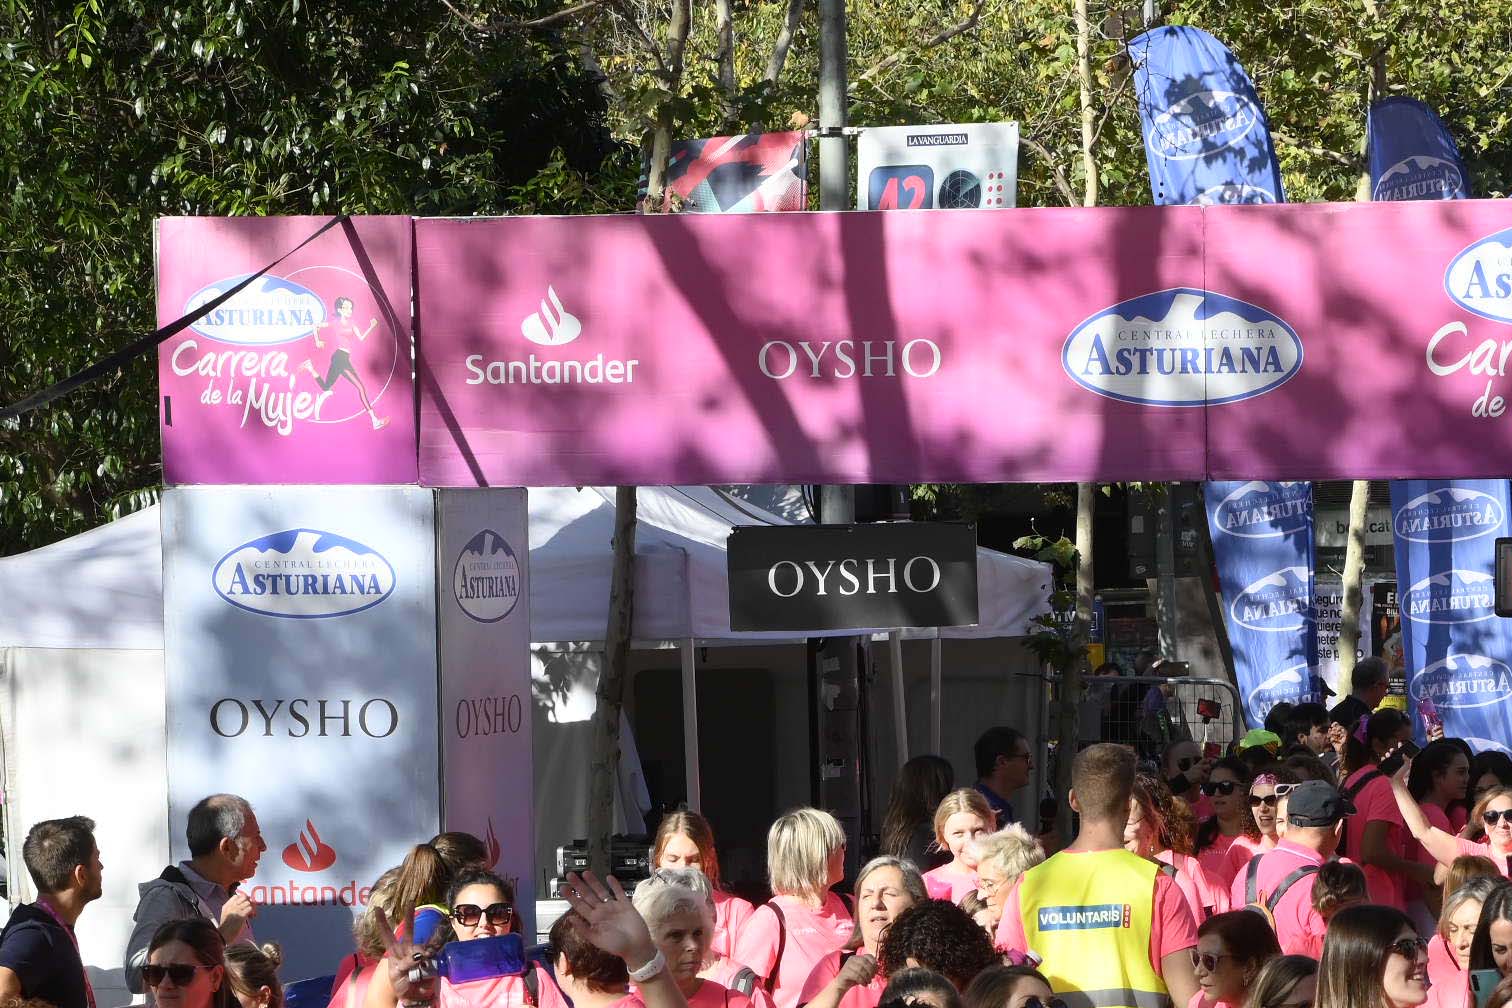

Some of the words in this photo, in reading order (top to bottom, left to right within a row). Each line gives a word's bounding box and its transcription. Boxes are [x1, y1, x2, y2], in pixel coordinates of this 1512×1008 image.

[171, 340, 289, 377] Carrera
[466, 353, 639, 385] Santander
[758, 338, 942, 379] OYSHO
[1081, 333, 1285, 376] ASTURIANA
[200, 377, 222, 404] de
[227, 377, 243, 404] la
[240, 374, 334, 435] Mujer
[1471, 379, 1505, 418] de
[226, 562, 383, 597] ASTURIANA
[255, 559, 314, 568] CENTRAL
[768, 556, 941, 598] OYSHO
[459, 567, 519, 601] ASTURIANA
[209, 698, 400, 739] OYSHO
[455, 694, 522, 739] OYSHO
[1040, 910, 1120, 926] VOLUNTARIS
